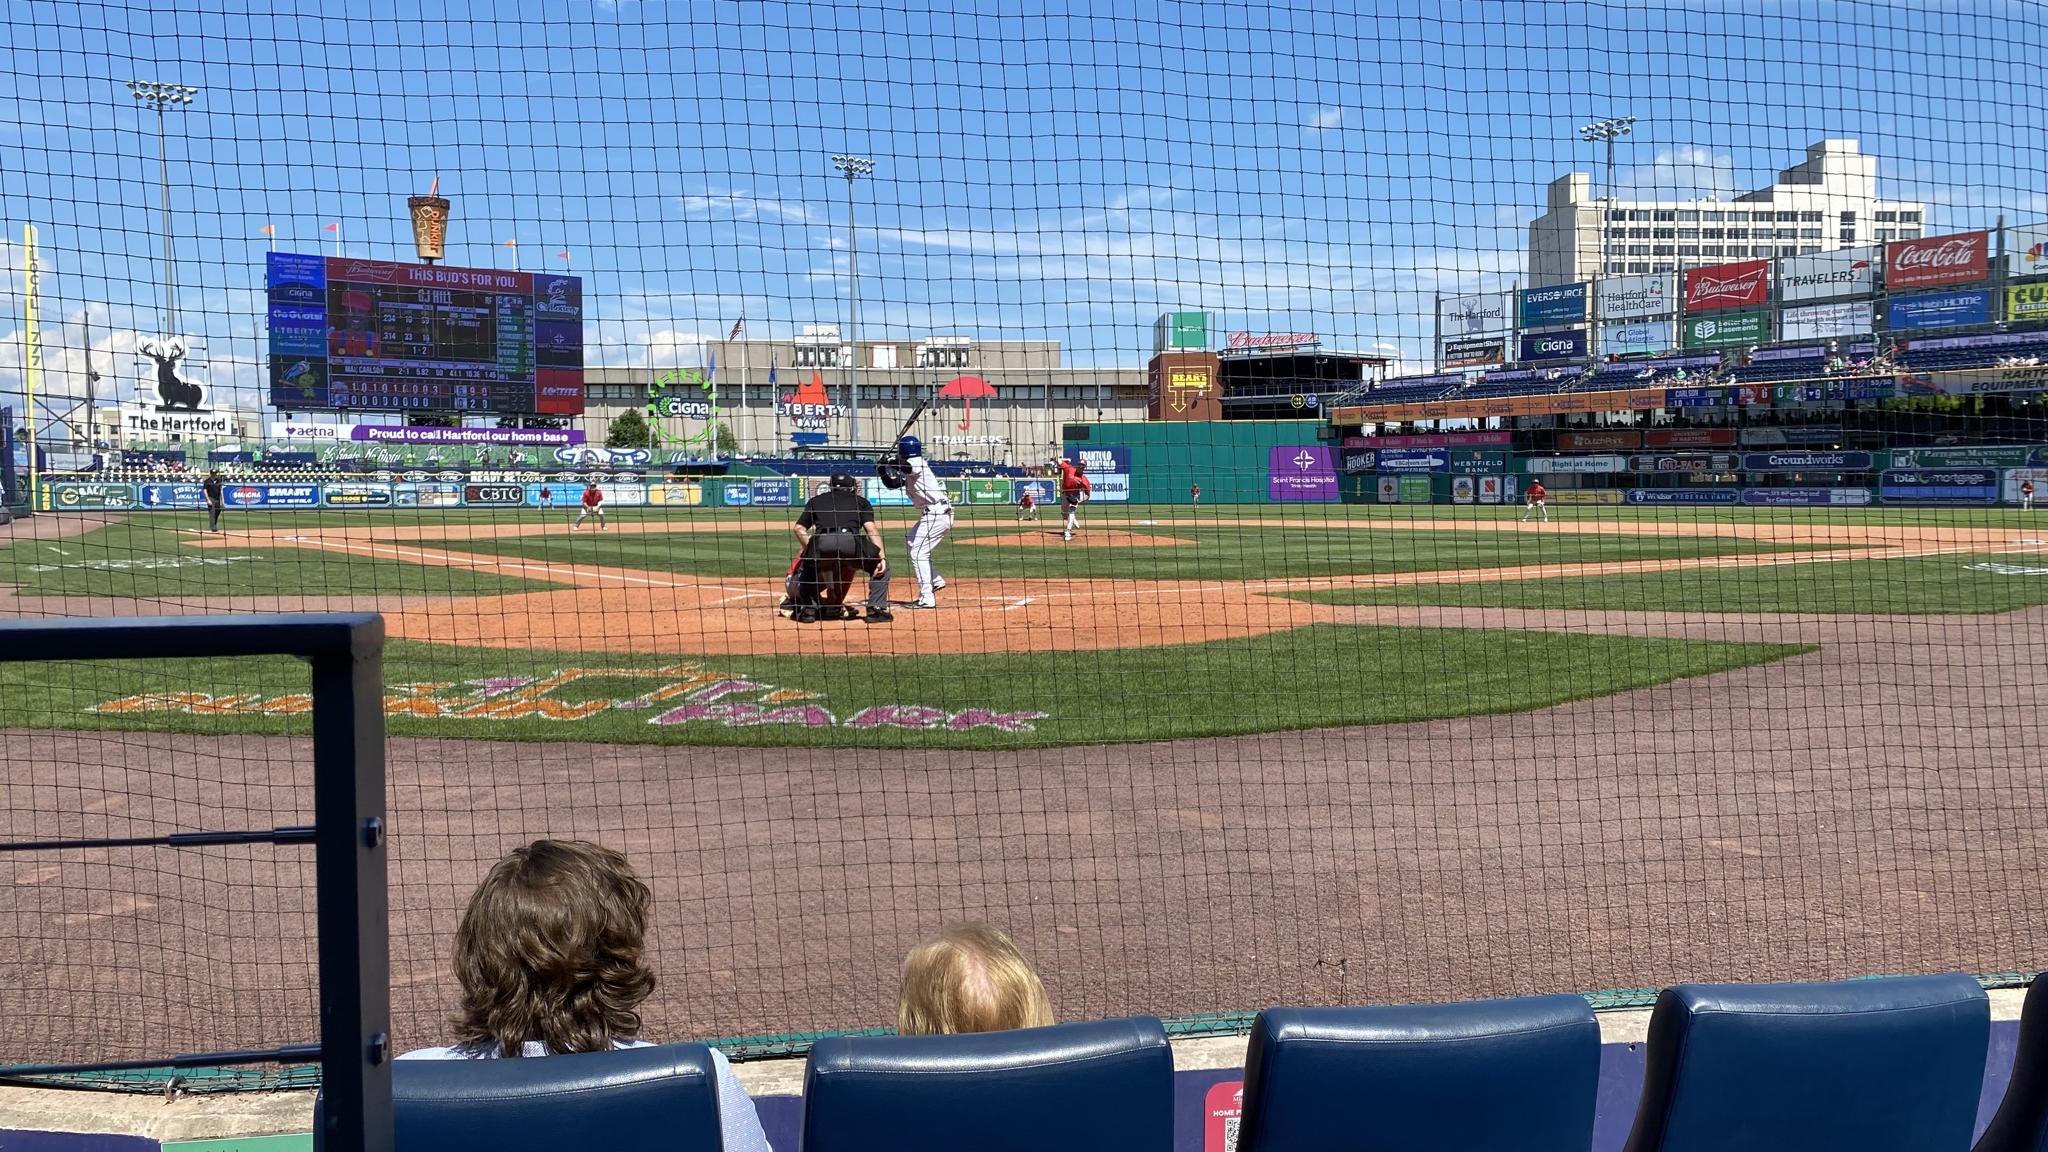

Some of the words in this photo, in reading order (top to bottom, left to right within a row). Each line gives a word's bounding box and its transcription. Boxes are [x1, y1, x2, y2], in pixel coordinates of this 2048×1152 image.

[1895, 239, 1977, 270] Coca-Cola
[29, 250, 39, 309] LOCAL
[409, 269, 433, 281] THIS
[436, 272, 469, 284] BUD'S
[472, 274, 491, 286] FOR
[496, 276, 518, 288] YOU.
[1787, 270, 1854, 287] TRAVELERS
[1695, 279, 1757, 296] Budweiser
[1608, 289, 1647, 302] Hartford
[1943, 296, 1982, 307] Home
[1608, 300, 1661, 312] HealthCare
[1450, 312, 1463, 322] The
[1466, 307, 1500, 320] Hartford
[1228, 331, 1316, 348] Budweiser
[31, 331, 41, 367] 777
[775, 403, 846, 416] LIBERTY
[129, 416, 158, 430] The
[162, 416, 225, 431] Hartford
[797, 419, 826, 428] BANK
[297, 427, 334, 437] aetna
[369, 429, 403, 439] Proud
[406, 430, 418, 439] to
[420, 430, 441, 439] call
[443, 430, 490, 441] Hartford
[492, 433, 510, 441] our
[512, 431, 541, 441] home
[543, 432, 568, 442] base
[934, 435, 1003, 446] TRAVELERS
[1347, 452, 1374, 469] HOOKER
[1552, 460, 1570, 469] Right
[1588, 460, 1608, 468] Home
[1769, 454, 1842, 465] Groundworks
[1933, 474, 1985, 485] mortgage
[269, 488, 313, 496] SMART
[479, 488, 520, 500] CBTG
[652, 703, 1048, 733] PARK
